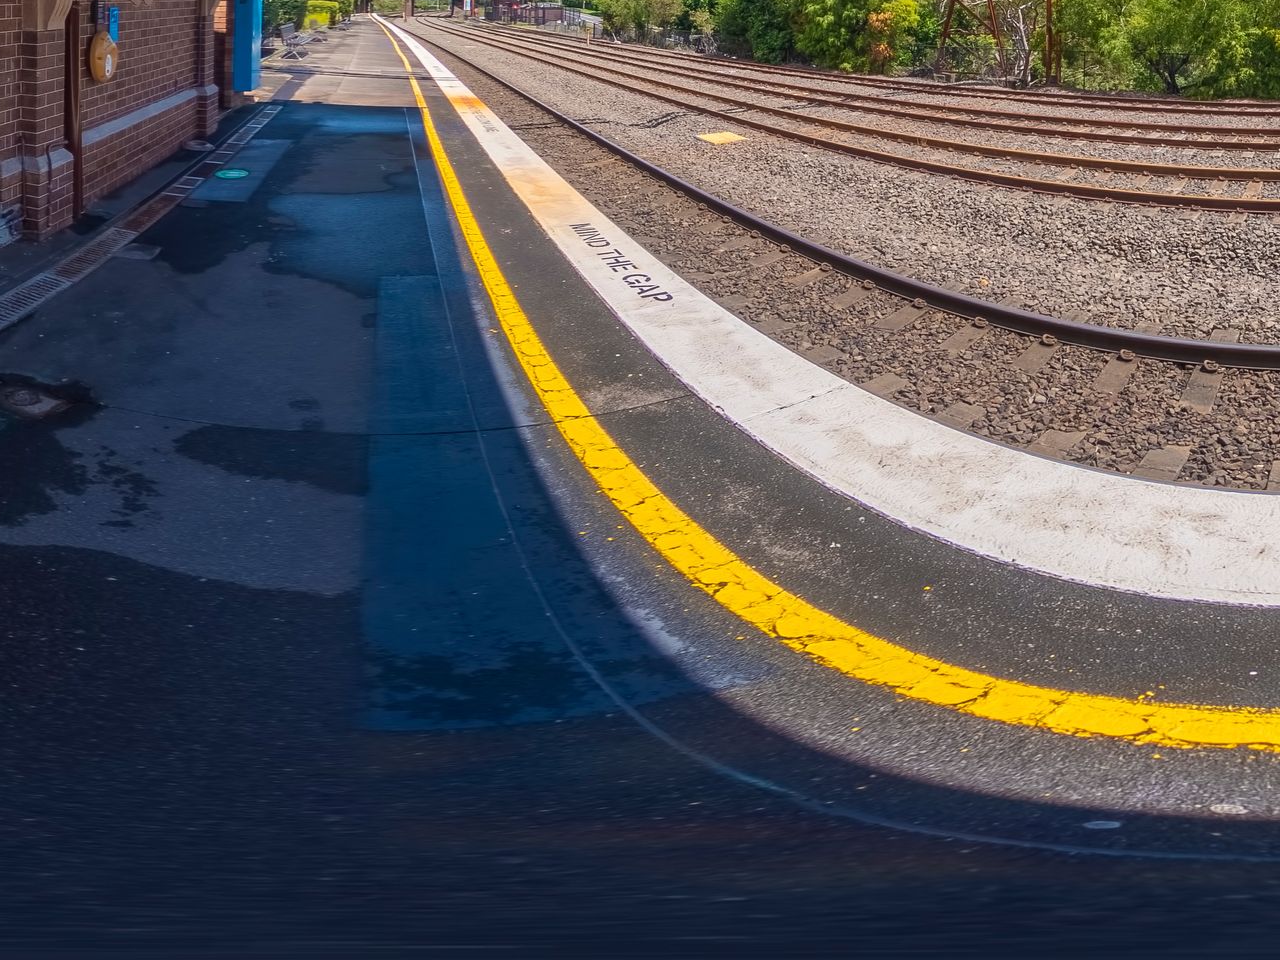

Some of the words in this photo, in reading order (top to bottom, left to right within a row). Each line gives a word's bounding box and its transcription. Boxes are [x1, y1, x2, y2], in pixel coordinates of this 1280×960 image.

[569, 223, 610, 248] MIND
[597, 249, 639, 272] THE
[622, 273, 674, 302] GAP
